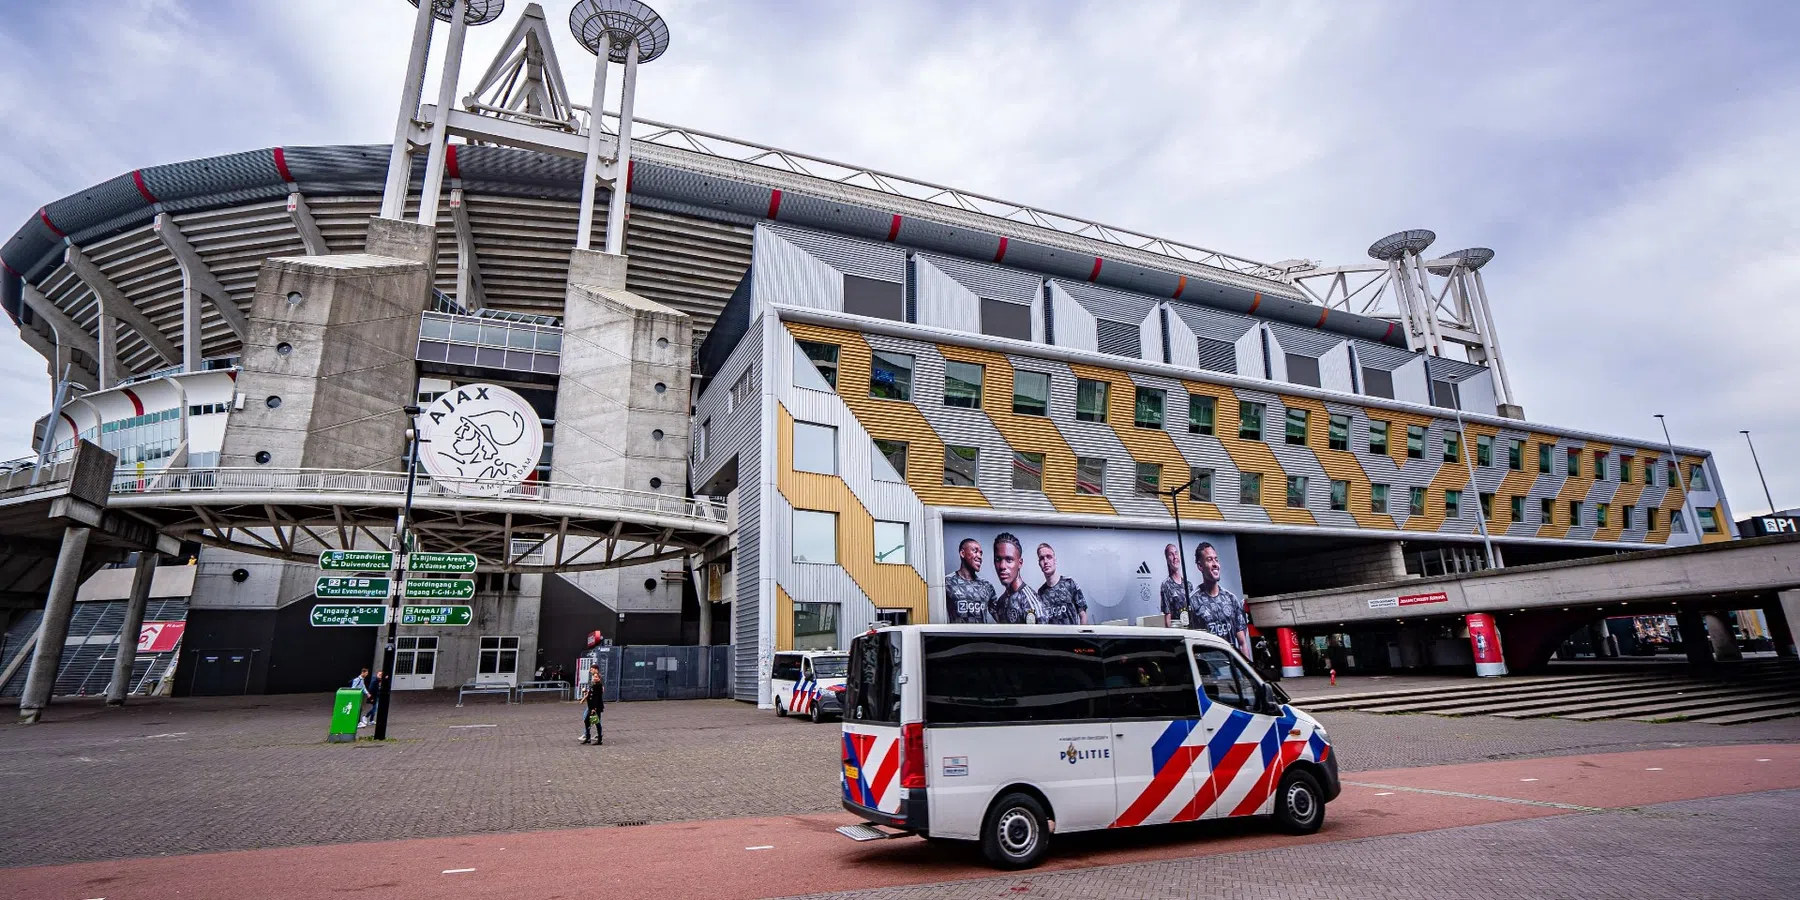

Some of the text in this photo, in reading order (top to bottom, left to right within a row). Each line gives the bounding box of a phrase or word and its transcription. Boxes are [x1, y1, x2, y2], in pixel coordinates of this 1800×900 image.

[429, 387, 489, 425] AJAX
[480, 457, 532, 490] AMRDAM
[1776, 518, 1797, 533] P1
[1060, 749, 1110, 764] POLITIE
